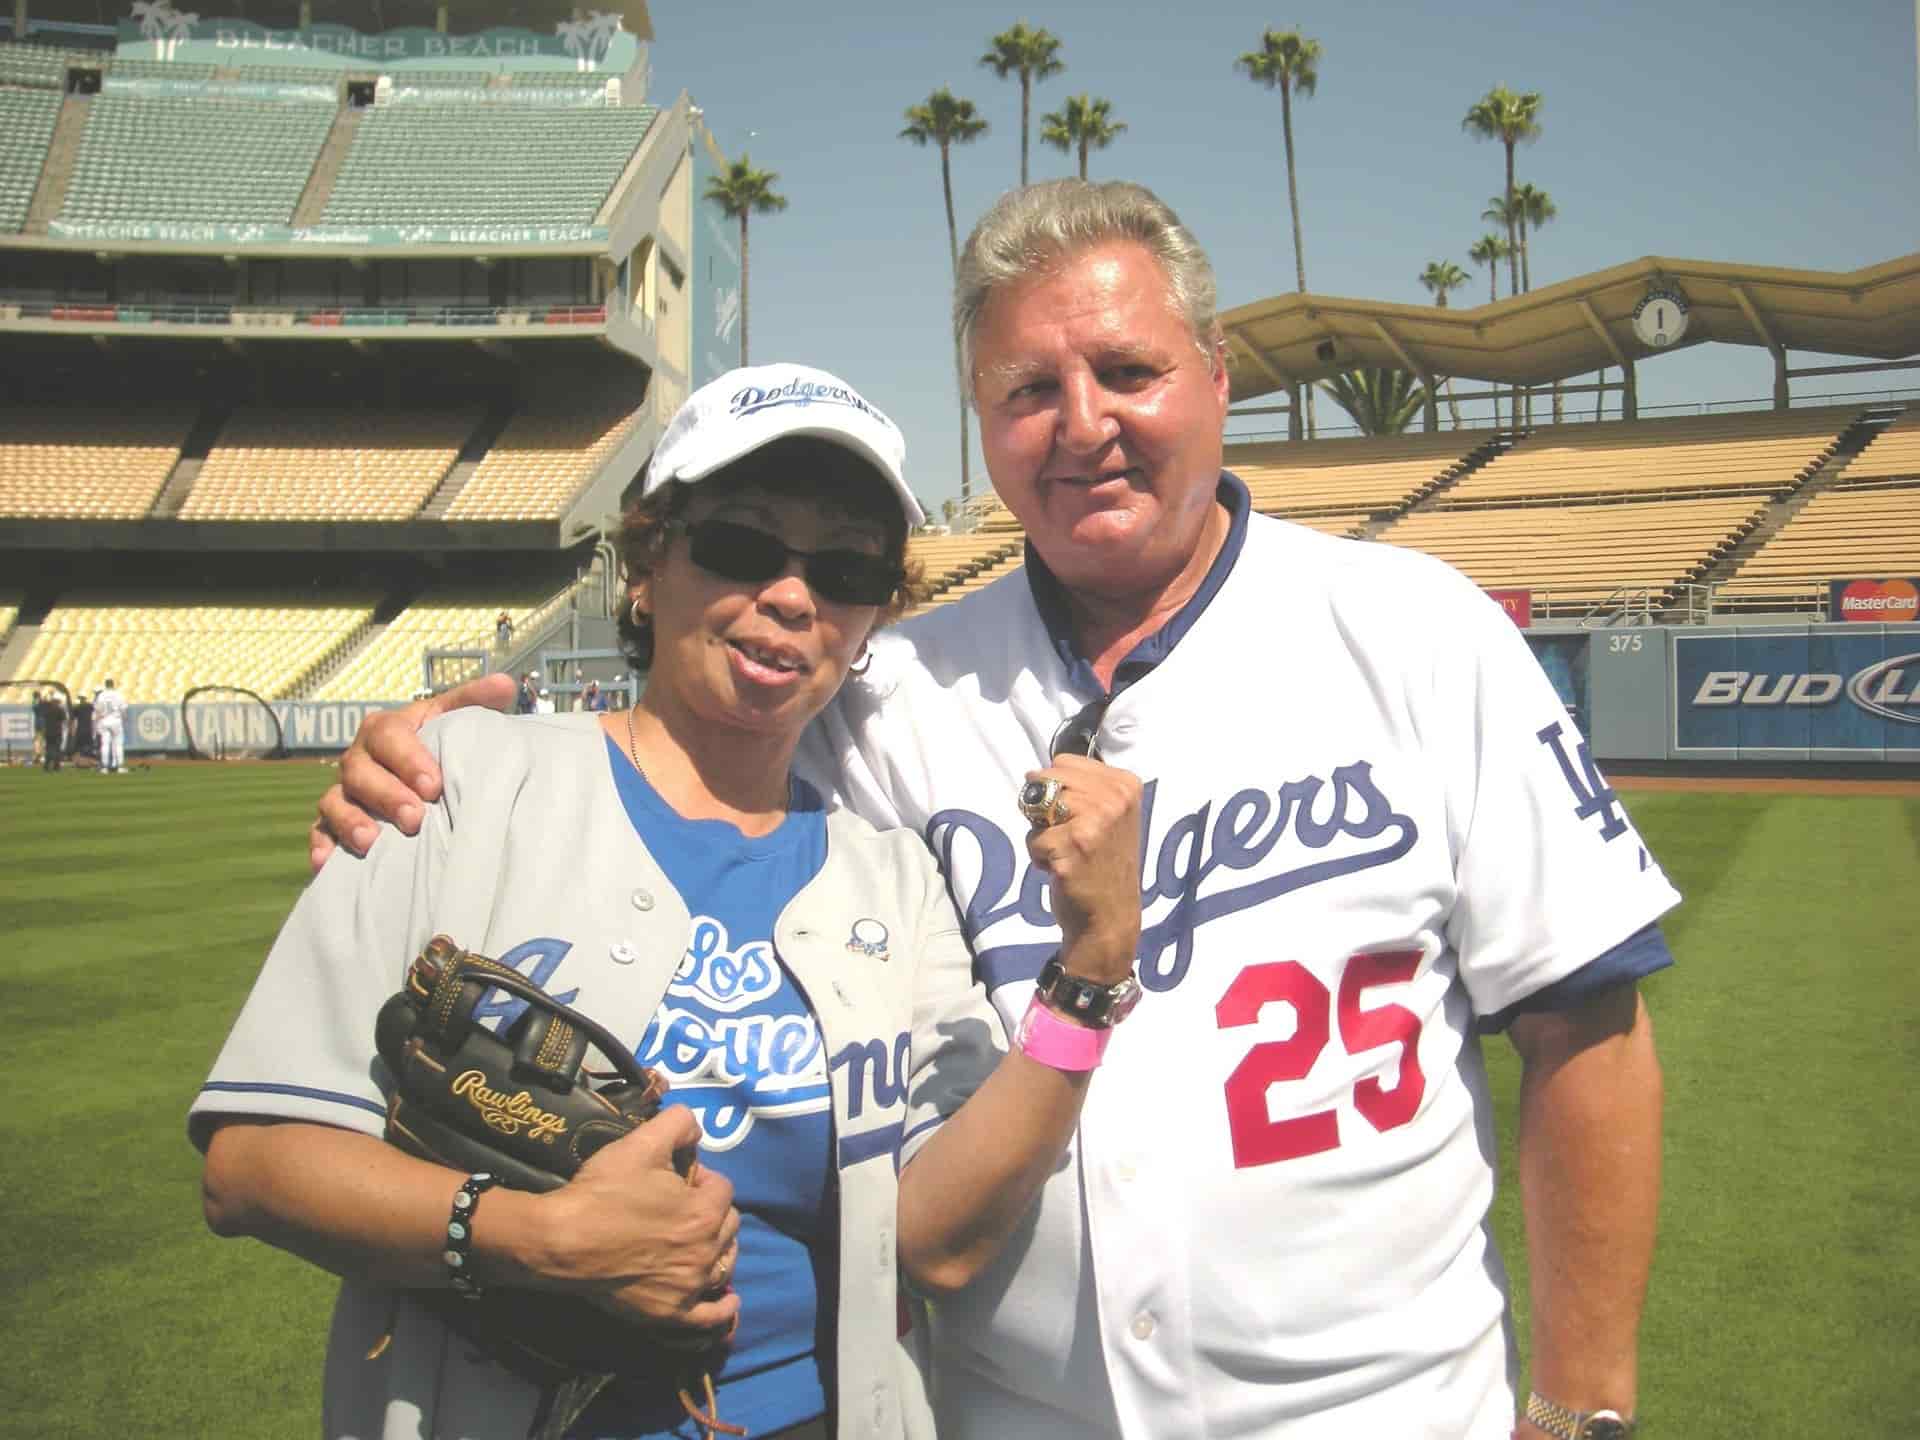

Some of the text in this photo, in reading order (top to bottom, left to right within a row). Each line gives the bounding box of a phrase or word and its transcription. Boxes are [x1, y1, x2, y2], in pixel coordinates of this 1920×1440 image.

[215, 29, 539, 56] BLEACHER BEACH
[450, 228, 592, 242] BLEACHER BEACH
[1842, 596, 1918, 610] MasterCard
[1608, 635, 1643, 653] 375
[1692, 671, 1843, 704] BUD
[174, 705, 384, 745] MANNYWOO
[1536, 720, 1628, 843] LA
[927, 758, 1419, 993] Dogers
[672, 922, 772, 998] Los
[1215, 949, 1427, 1169] 25
[452, 1068, 568, 1140] Rawlings
